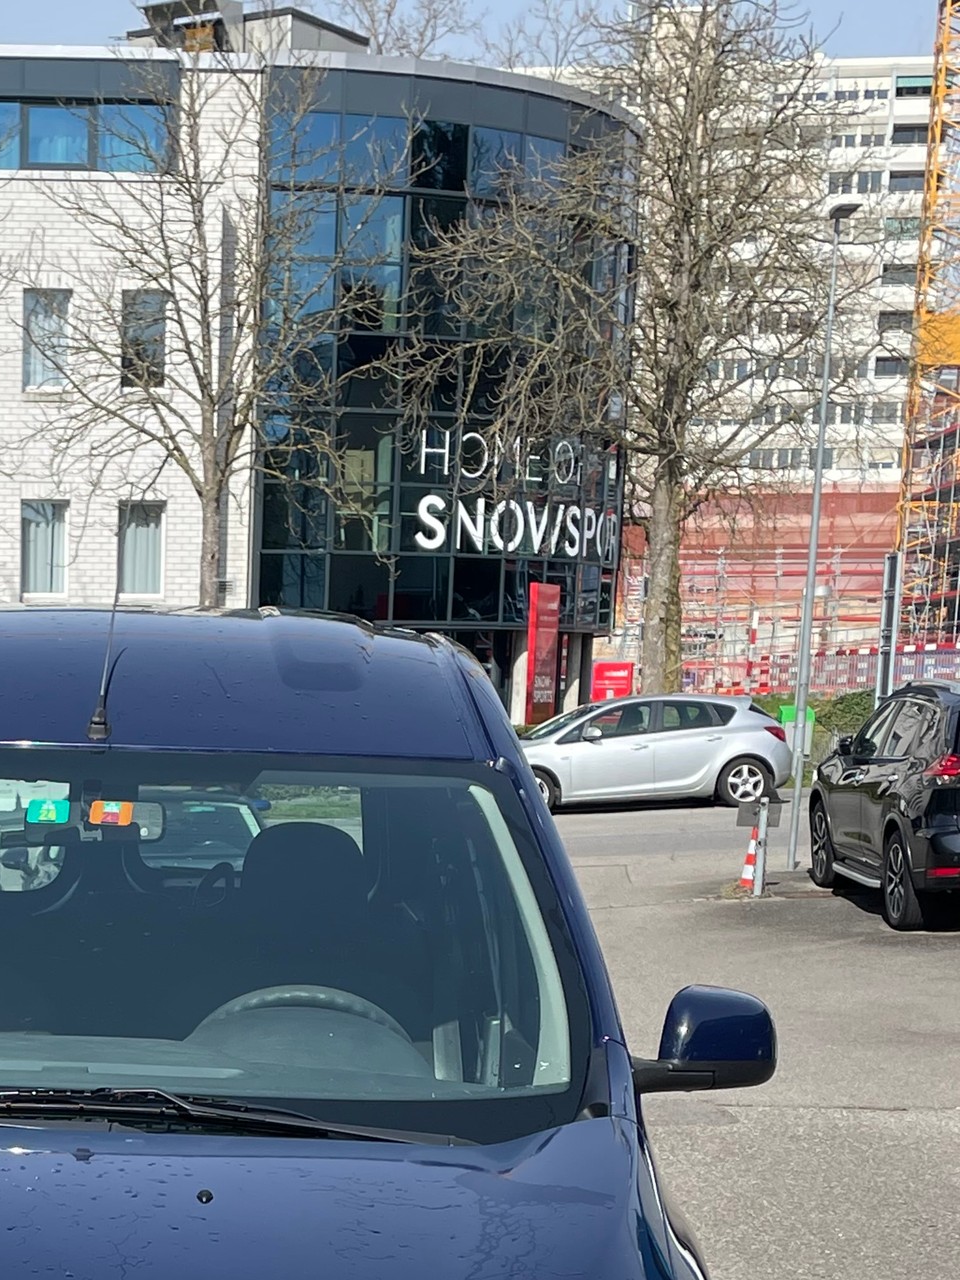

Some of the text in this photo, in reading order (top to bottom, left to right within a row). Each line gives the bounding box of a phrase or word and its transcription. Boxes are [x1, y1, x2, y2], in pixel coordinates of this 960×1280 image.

[420, 429, 543, 481] HOME
[533, 690, 553, 703] SPORTS
[38, 809, 56, 820] 24
